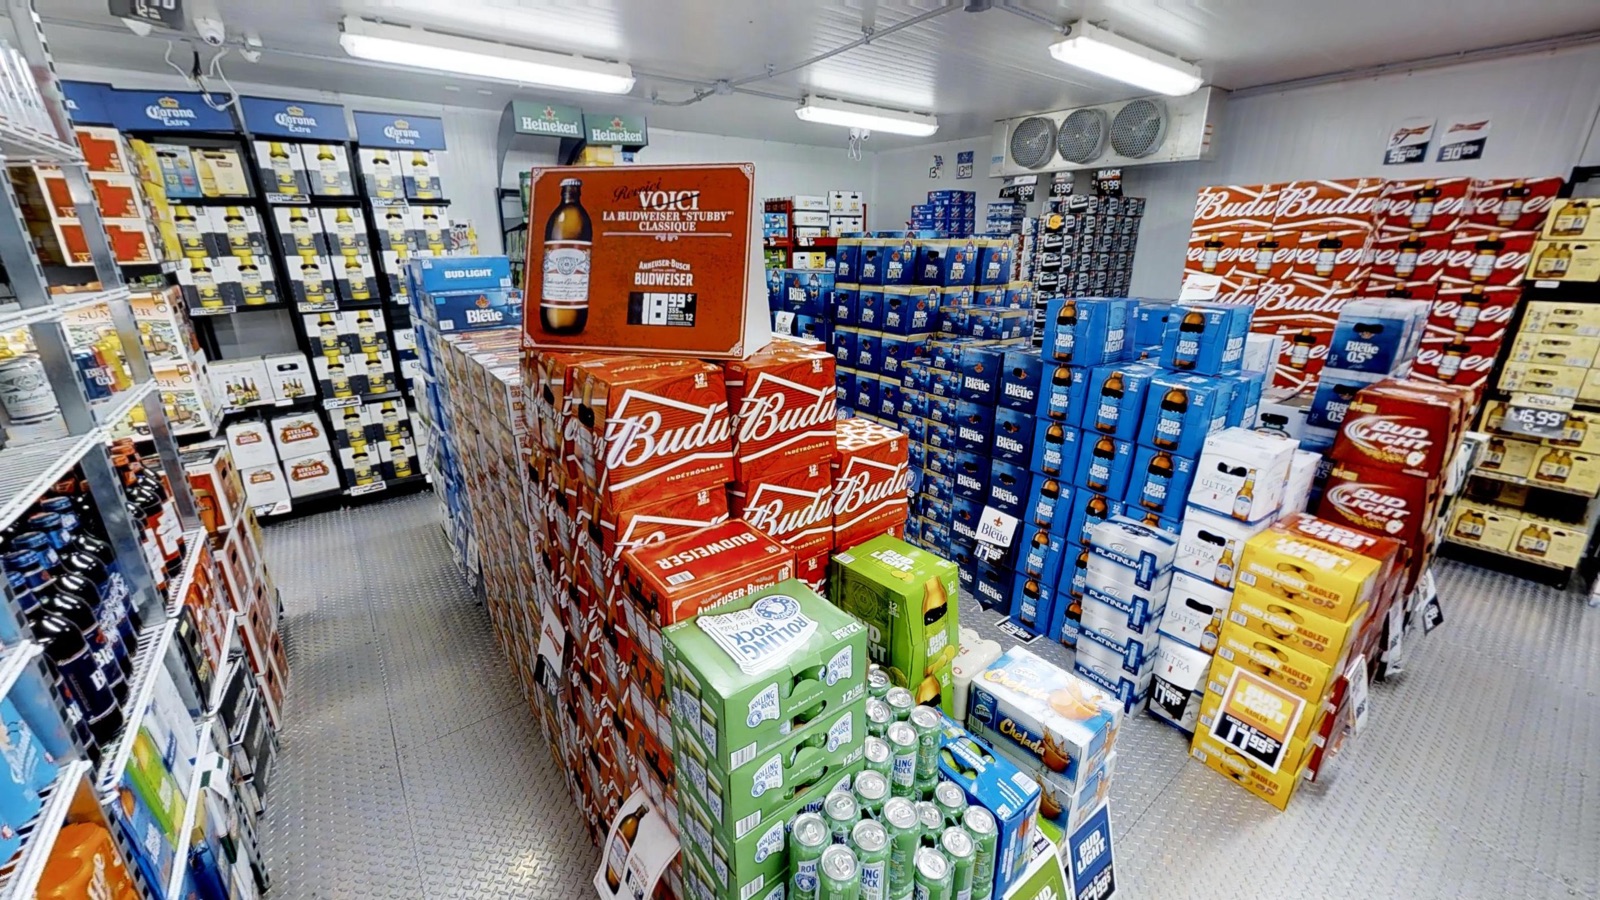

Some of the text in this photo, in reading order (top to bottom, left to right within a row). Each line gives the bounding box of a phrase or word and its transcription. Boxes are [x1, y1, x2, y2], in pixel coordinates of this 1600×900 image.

[146, 103, 196, 120] Corona
[274, 113, 317, 127] Corona
[522, 117, 578, 134] Heineken
[384, 126, 420, 140] Corona
[592, 128, 642, 142] Heineken
[1098, 169, 1121, 179] BLACK
[639, 190, 700, 211] VOICI
[603, 211, 617, 222] LA
[618, 211, 680, 222] BUDWEISER
[639, 221, 696, 232] CLASSIQUE
[444, 268, 492, 278] BUD LIGHT
[634, 272, 693, 287] BUDWEISER
[466, 309, 503, 324] Bleue
[685, 313, 694, 322] 12
[1058, 333, 1073, 343] BUD
[1108, 329, 1124, 342] BUD
[1055, 338, 1074, 348] LIGHT
[1105, 339, 1125, 352] LIGHT
[1179, 340, 1197, 349] BUD
[1228, 337, 1243, 351] BUD
[1176, 346, 1199, 355] LIGHT
[1222, 347, 1243, 363] LIGHT
[694, 373, 705, 382] 12
[1050, 398, 1068, 407] LIGHT
[1052, 393, 1068, 402] BUD
[1098, 410, 1118, 420] LIGHT
[1101, 404, 1117, 414] BUD
[285, 426, 313, 436] STELLA
[1157, 425, 1182, 436] LIGHT
[1161, 419, 1180, 429] BUD
[1371, 420, 1430, 439] BUD
[287, 431, 314, 441] ARTOIS
[1358, 428, 1433, 452] LIGHT
[1046, 450, 1060, 459] BUD
[296, 466, 322, 475] STELLA
[297, 469, 324, 480] ARTOIS
[1090, 469, 1109, 480] LIGHT
[1092, 463, 1108, 473] BUD
[1143, 486, 1167, 500] LIGHT
[1147, 482, 1166, 492] BUD
[1201, 478, 1234, 495] ULTRA
[697, 491, 707, 500] 12
[1351, 487, 1407, 509] BUD
[1341, 496, 1411, 519] LIGHT
[981, 522, 1008, 545] Bleue
[655, 532, 758, 571] BUDWEISER
[883, 550, 915, 565] BUD
[1095, 547, 1142, 570] PLATINUM
[1184, 544, 1216, 562] ULTRA
[870, 551, 914, 572] LIGHT
[1307, 583, 1340, 602] RADLER
[1089, 589, 1134, 614] PLATINUM
[1170, 611, 1201, 629] ULTRA
[729, 622, 777, 645] ROCK
[1064, 625, 1078, 634] BUD
[1296, 624, 1329, 645] RADLER
[740, 616, 808, 660] ROLLING
[929, 629, 948, 648] BUD
[1085, 630, 1129, 655] PLATINUM
[829, 651, 850, 670] ROLLING
[1079, 665, 1120, 694] PLATINUM
[751, 689, 775, 711] ROLLING
[761, 699, 776, 711] ROCK
[830, 719, 850, 736] ROLLING
[1000, 718, 1045, 756] Chelada
[1227, 723, 1250, 750] 17
[755, 760, 779, 781] ROLLING
[764, 769, 779, 781] ROCK
[757, 826, 782, 848] ROLLING
[767, 835, 782, 848] ROCK
[1079, 830, 1101, 853] BUD
[1077, 837, 1107, 875] LIGHT
